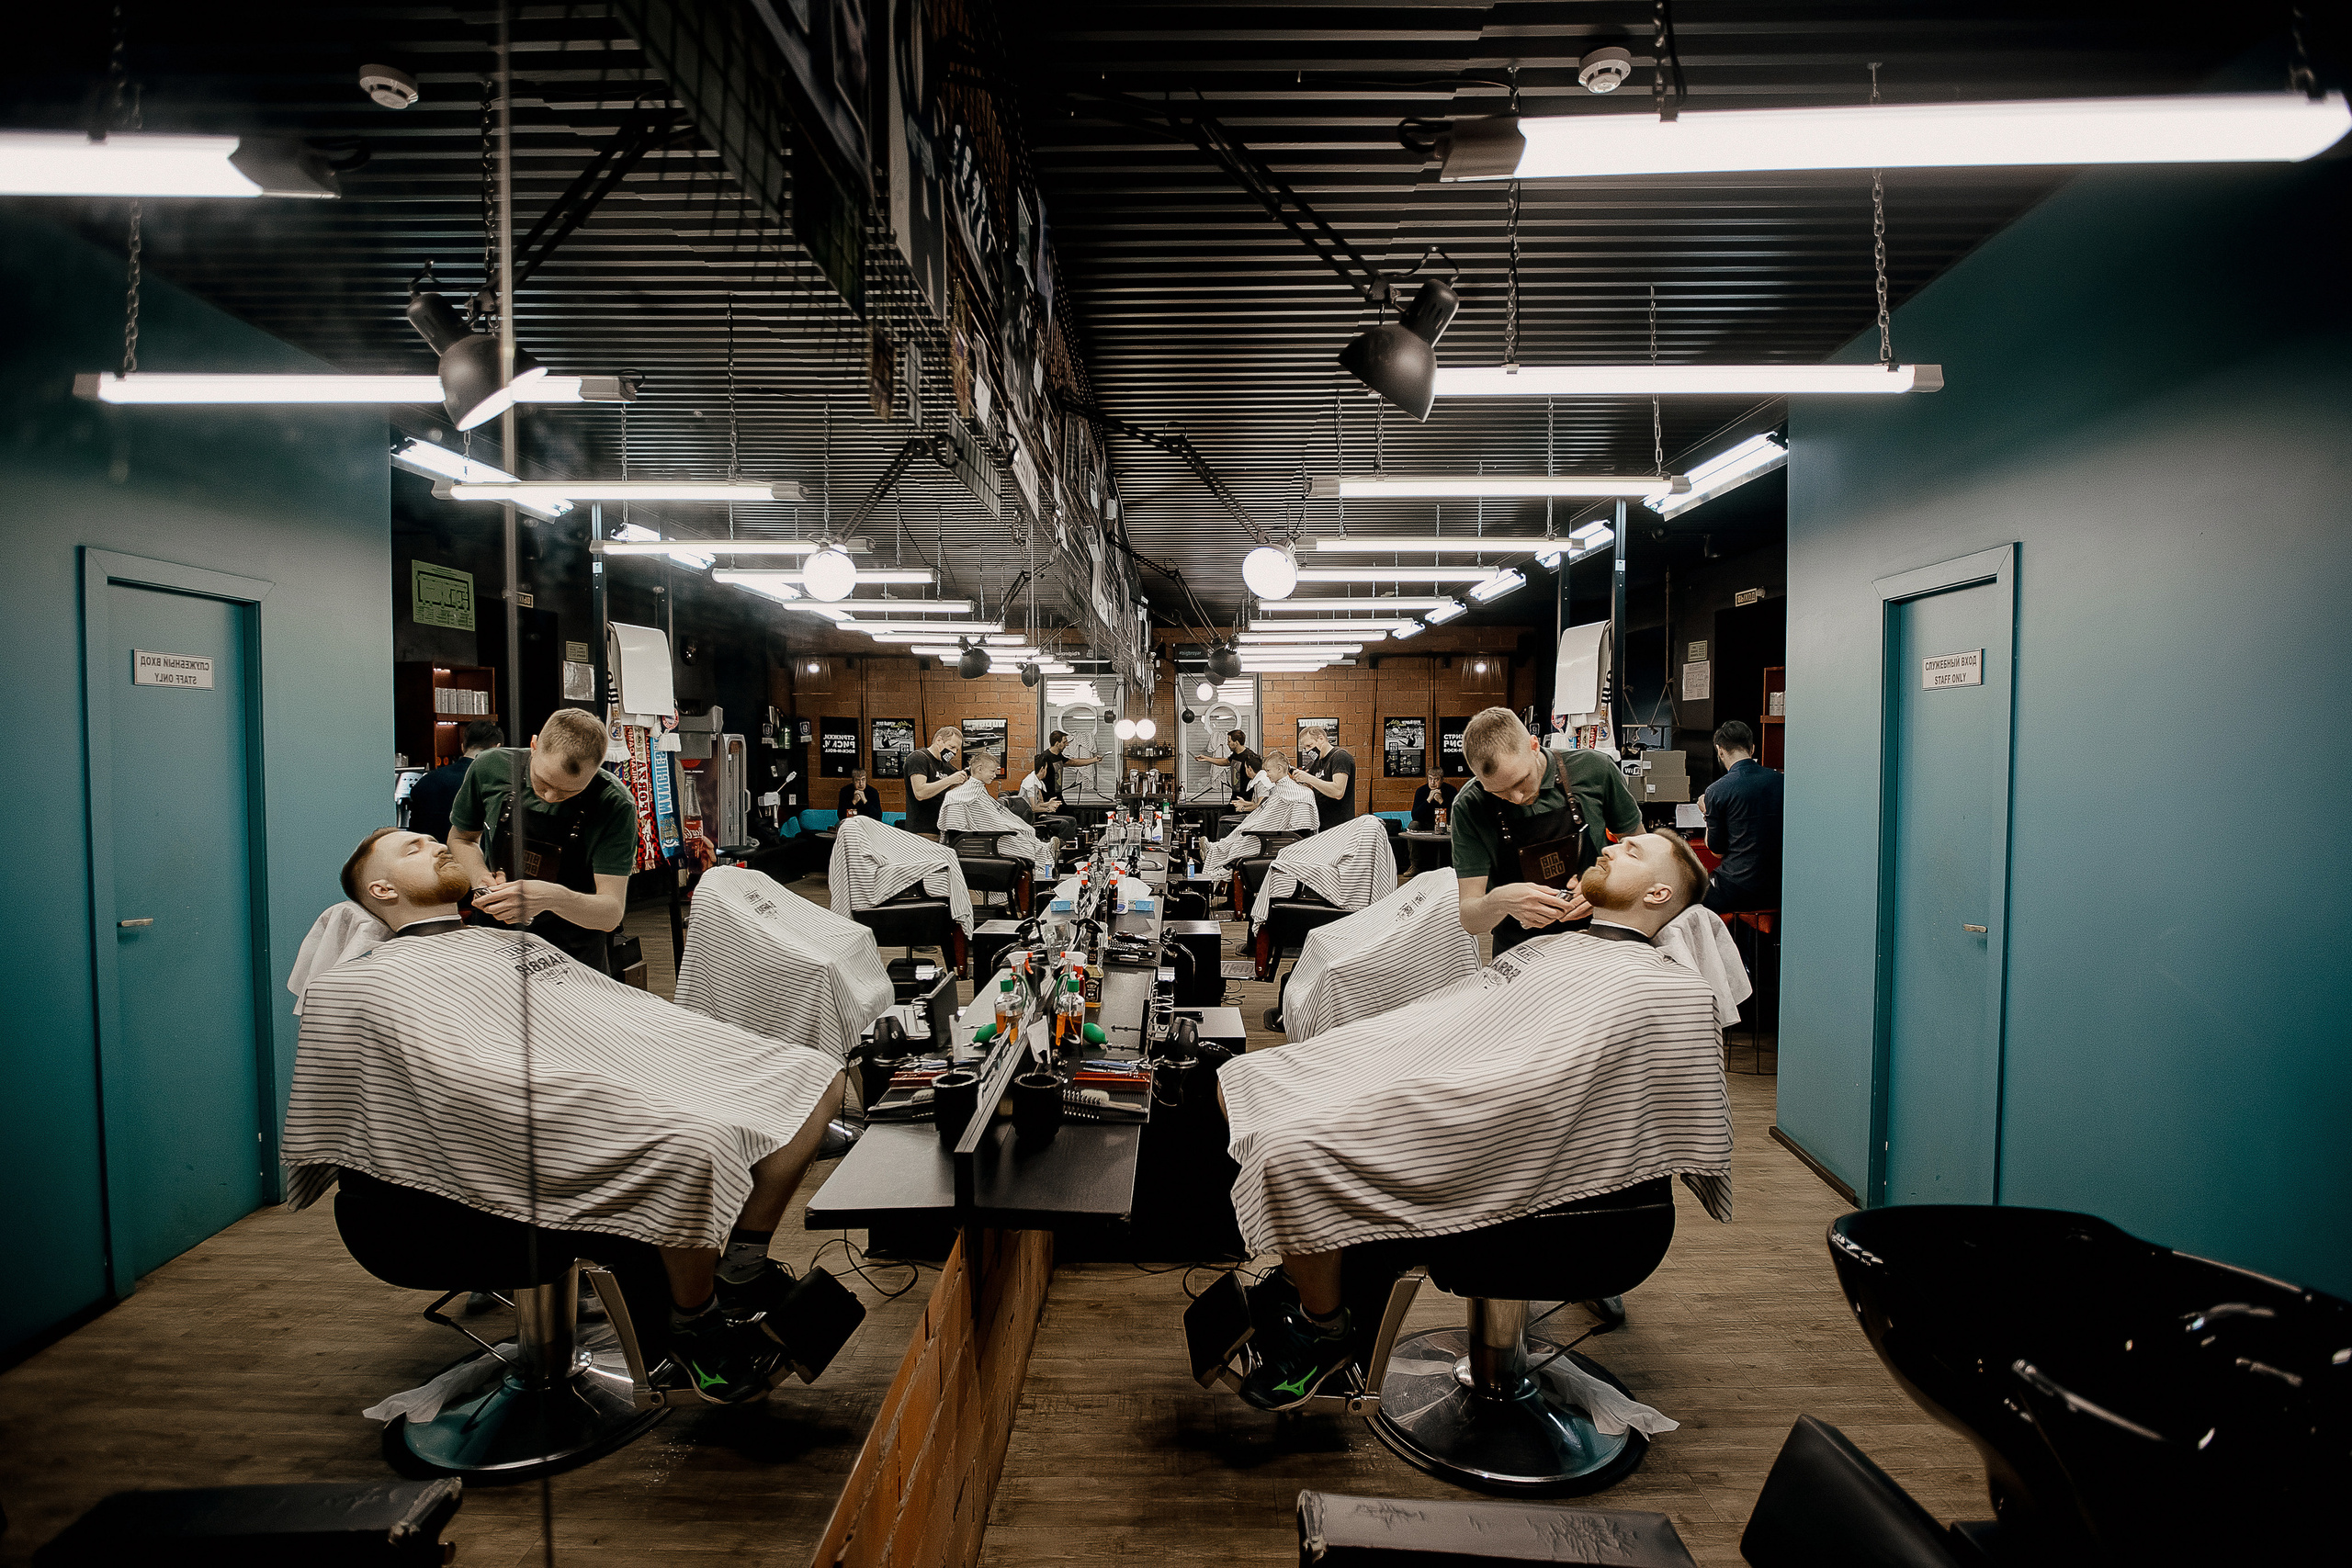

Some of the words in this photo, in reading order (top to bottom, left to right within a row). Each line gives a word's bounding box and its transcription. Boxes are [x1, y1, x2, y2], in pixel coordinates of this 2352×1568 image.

[1925, 656, 1961, 671] СЛУЖЕБНЫЙ
[1961, 655, 1977, 667] ВХОД
[1934, 674, 1951, 685] STAFF
[1951, 672, 1967, 683] ONLY
[1443, 739, 1464, 748] РИС
[1540, 852, 1560, 869] BIG
[1543, 860, 1566, 880] BRO
